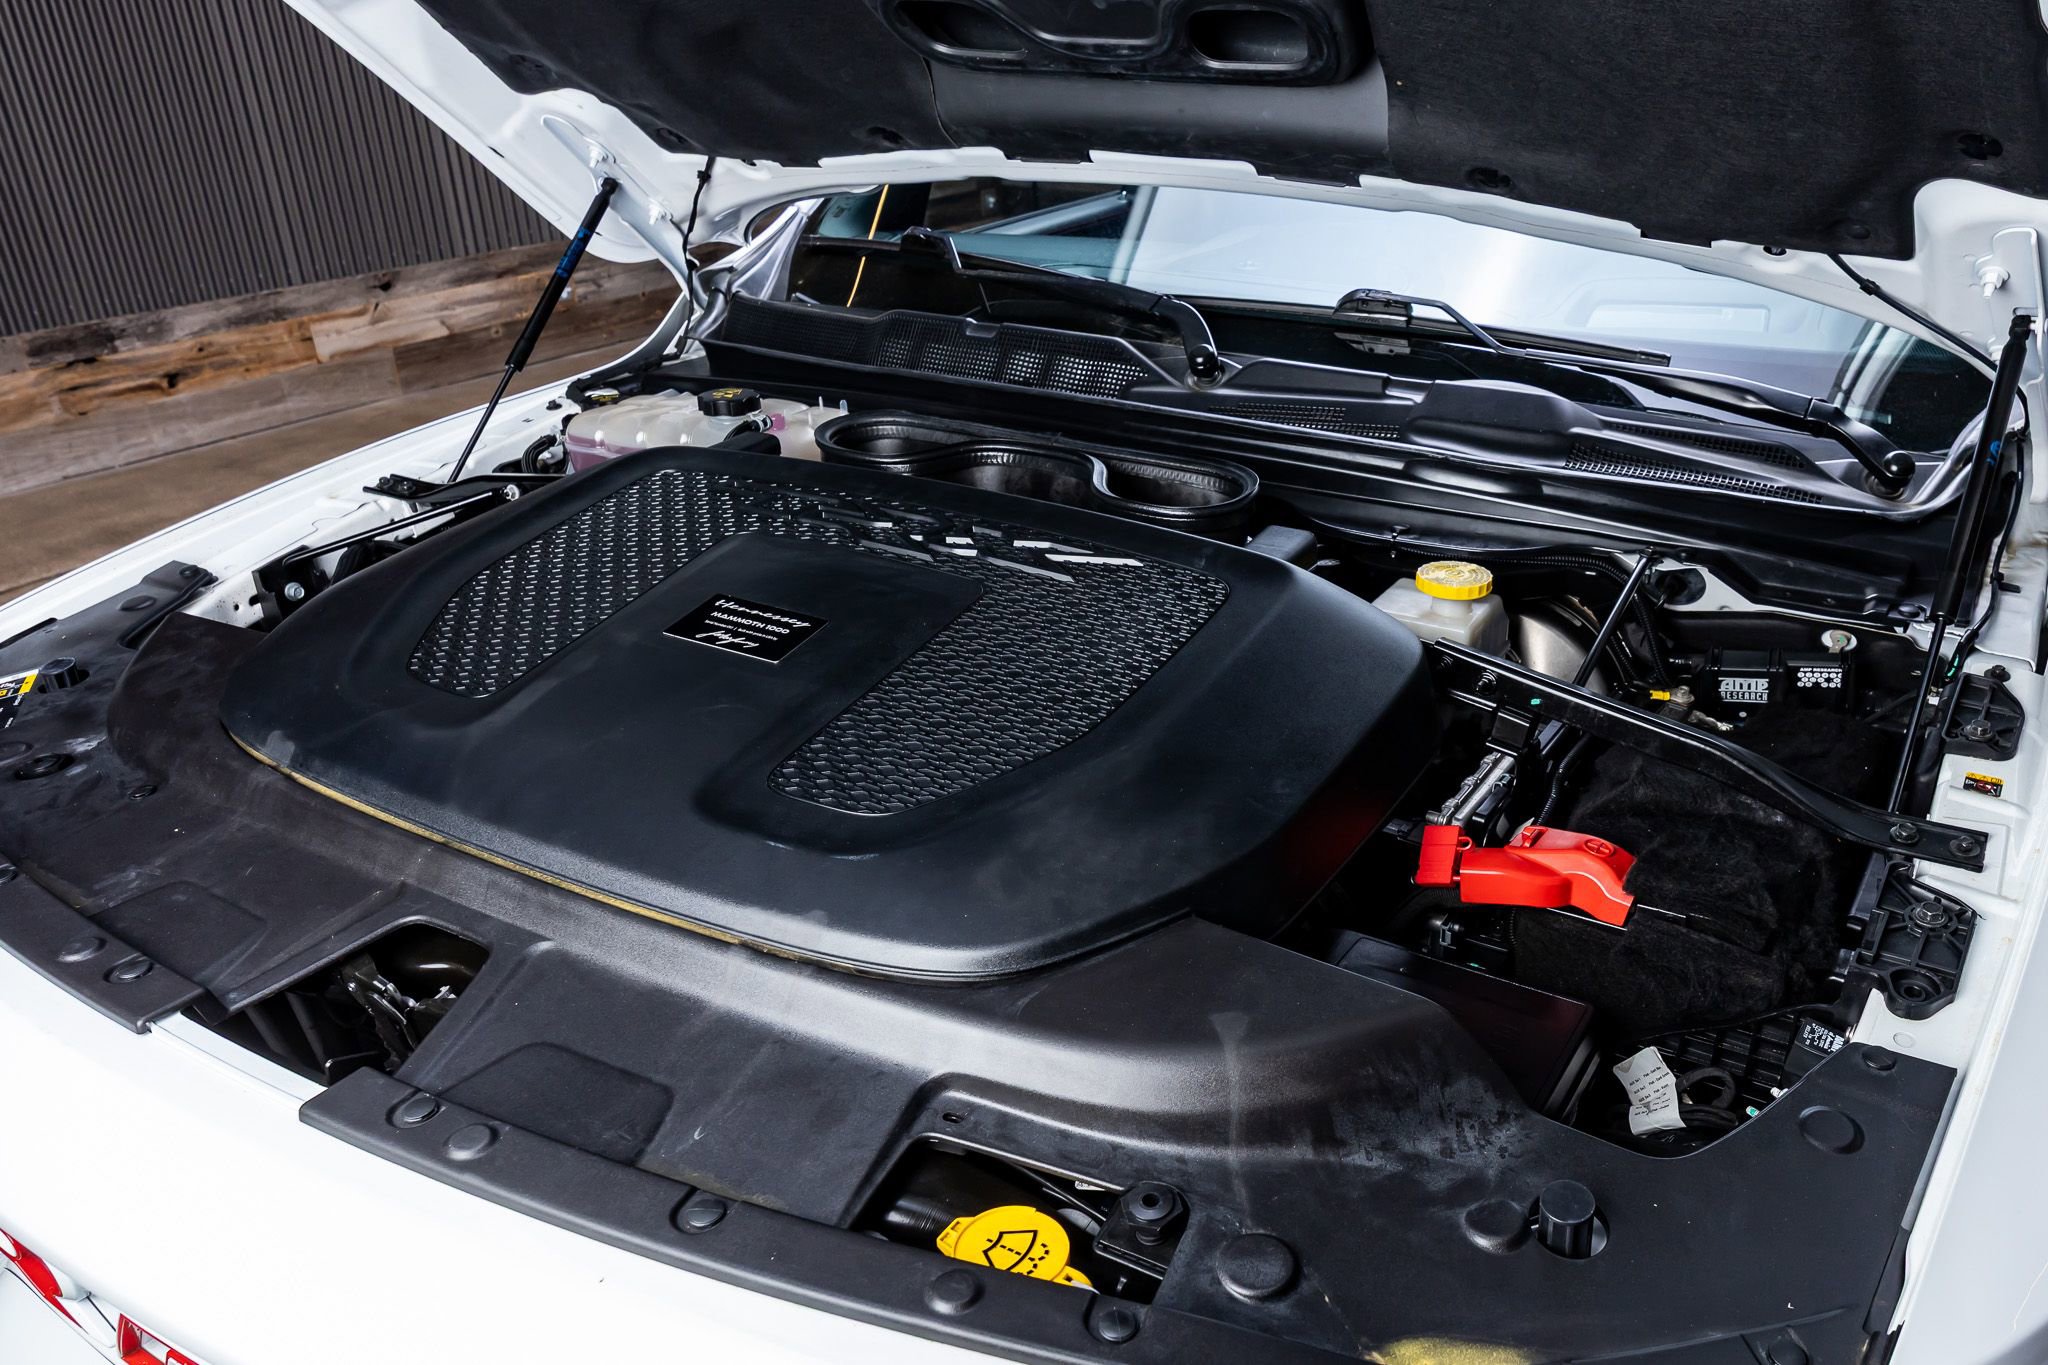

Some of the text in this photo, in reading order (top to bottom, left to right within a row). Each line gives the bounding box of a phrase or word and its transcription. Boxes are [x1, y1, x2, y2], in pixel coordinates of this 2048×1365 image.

[710, 611, 766, 628] MAMMOTH
[765, 624, 790, 634] 1000
[715, 599, 811, 628] Hennessey
[1719, 678, 1769, 691] AMP
[1720, 691, 1768, 701] RESEARCH
